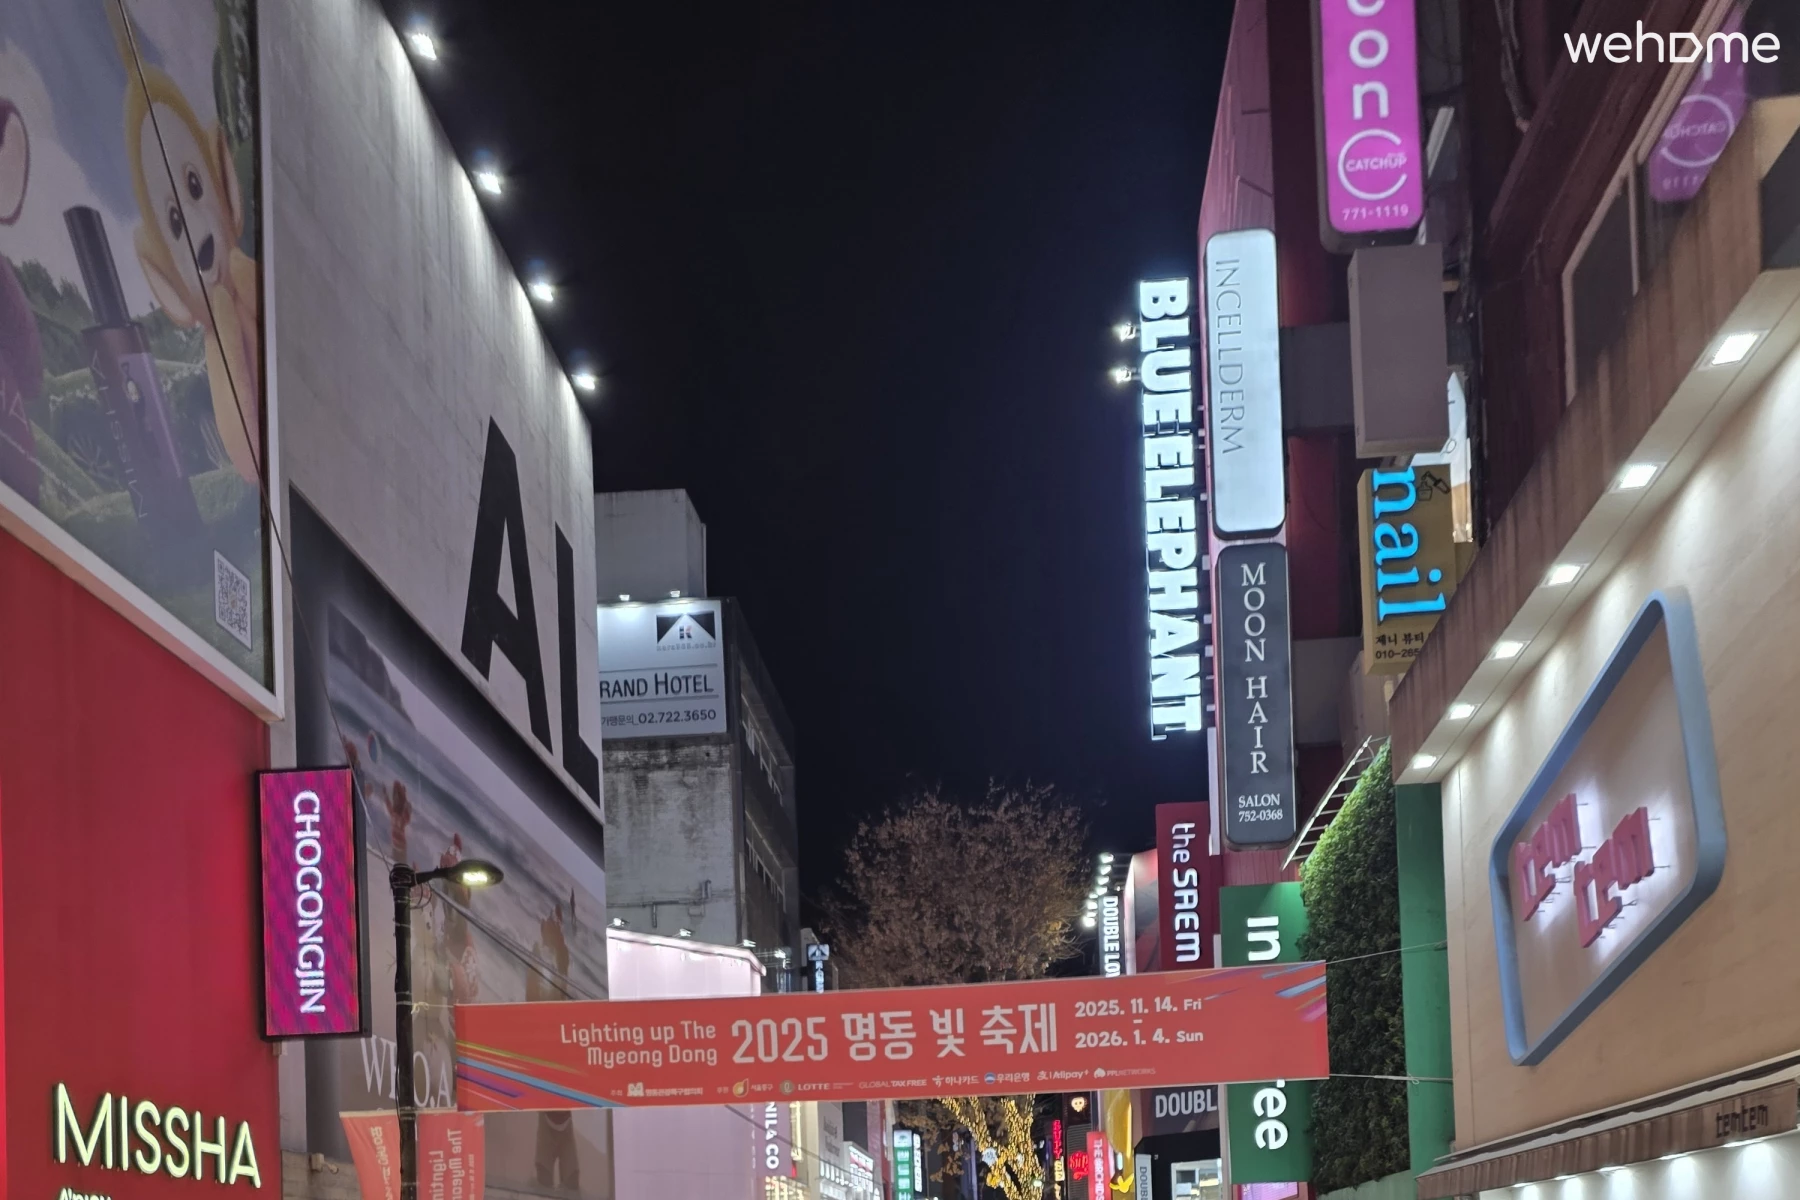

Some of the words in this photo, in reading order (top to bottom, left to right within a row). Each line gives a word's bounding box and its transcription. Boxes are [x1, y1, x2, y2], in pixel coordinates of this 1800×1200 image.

[1345, 156, 1407, 172] CATCHUP
[1342, 204, 1409, 221] 771-1119
[1215, 259, 1246, 455] INCELLDERM
[1371, 465, 1446, 624] nail
[1240, 562, 1267, 663] MOON
[1402, 631, 1425, 645] 뷰티
[654, 672, 715, 696] HOTEL
[1245, 674, 1269, 776] HAIR
[1238, 793, 1281, 808] SALON
[1238, 808, 1284, 823] 752-0368
[1172, 822, 1196, 863] the
[293, 789, 327, 1014] CHOGONGJIN
[1103, 896, 1121, 952] DOUBLE
[1074, 999, 1123, 1018] 2025.
[1130, 998, 1148, 1015] 11.
[1154, 996, 1178, 1014] 14.
[1183, 997, 1203, 1012] Fri
[560, 1022, 647, 1049] Lighting
[650, 1025, 676, 1044] up
[680, 1020, 717, 1041] The
[731, 1016, 829, 1064] 2025
[840, 1010, 917, 1062] 명동
[928, 1006, 966, 1059] 빛
[979, 1003, 1058, 1056] 축제
[1074, 1030, 1129, 1049] 2026.
[1152, 1029, 1171, 1045] 4.
[1176, 1029, 1204, 1043] Sun
[587, 1045, 663, 1069] Myeong
[668, 1044, 718, 1067] Dong
[797, 1082, 830, 1092] LOTTE
[858, 1080, 890, 1090] GLOBAL
[890, 1080, 907, 1088] TAX
[906, 1078, 928, 1087] FREE
[944, 1075, 980, 1087] 하나카드
[996, 1071, 1031, 1083] 우리은행
[55, 1082, 262, 1189] MISSHA
[765, 1144, 780, 1169] CO
